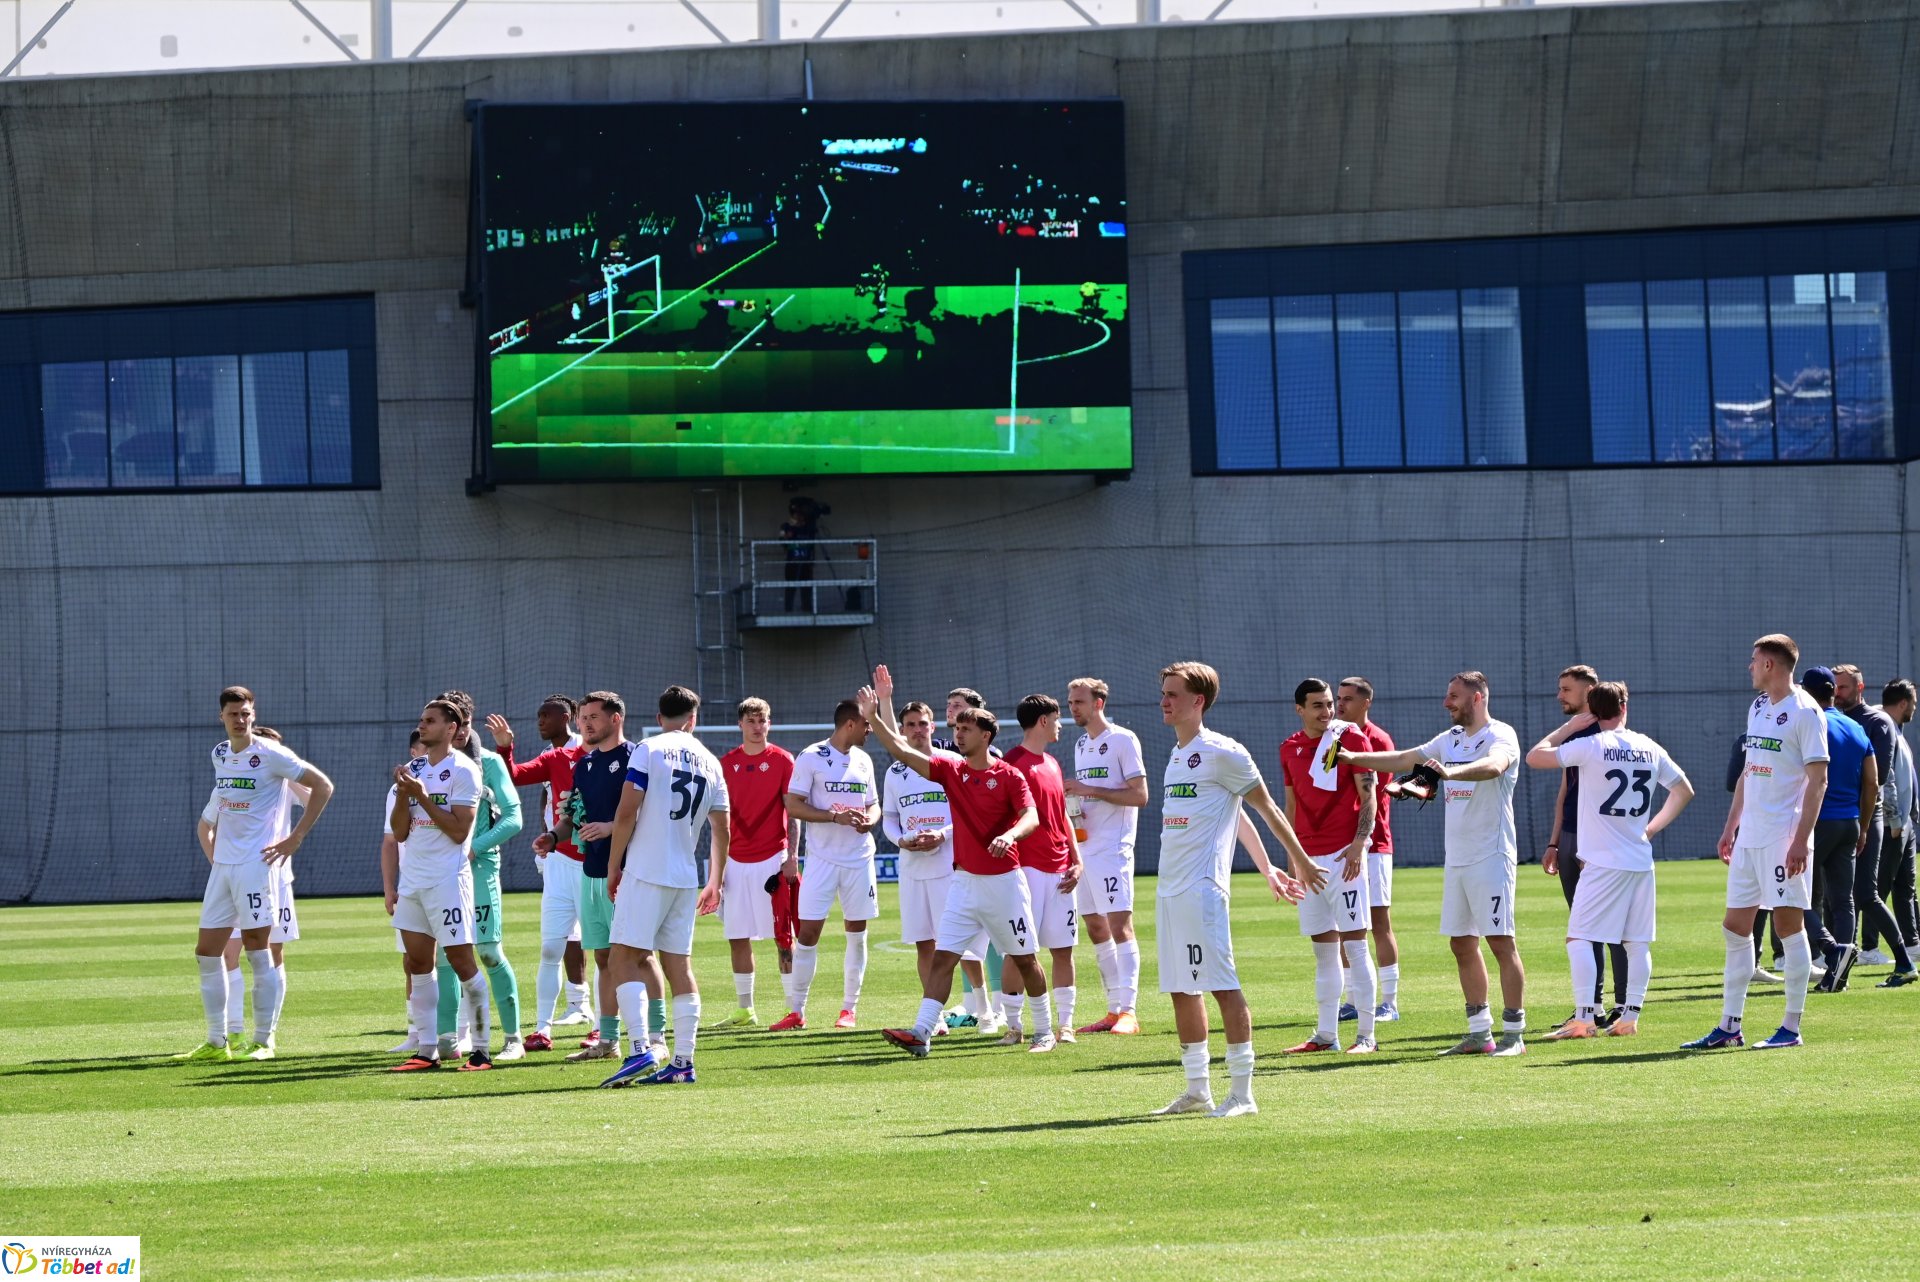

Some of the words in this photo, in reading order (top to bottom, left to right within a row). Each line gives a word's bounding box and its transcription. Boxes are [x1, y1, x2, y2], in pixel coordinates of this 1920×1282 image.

[669, 769, 707, 826] 37
[1599, 768, 1652, 818] 23
[1775, 865, 1785, 883] 9
[868, 885, 875, 900] 4
[1104, 877, 1118, 893] 12
[247, 893, 262, 909] 15
[1342, 890, 1357, 909] 17
[1491, 896, 1501, 914] 7
[443, 908, 462, 926] 20
[1009, 917, 1026, 935] 14
[1187, 944, 1203, 965] 10
